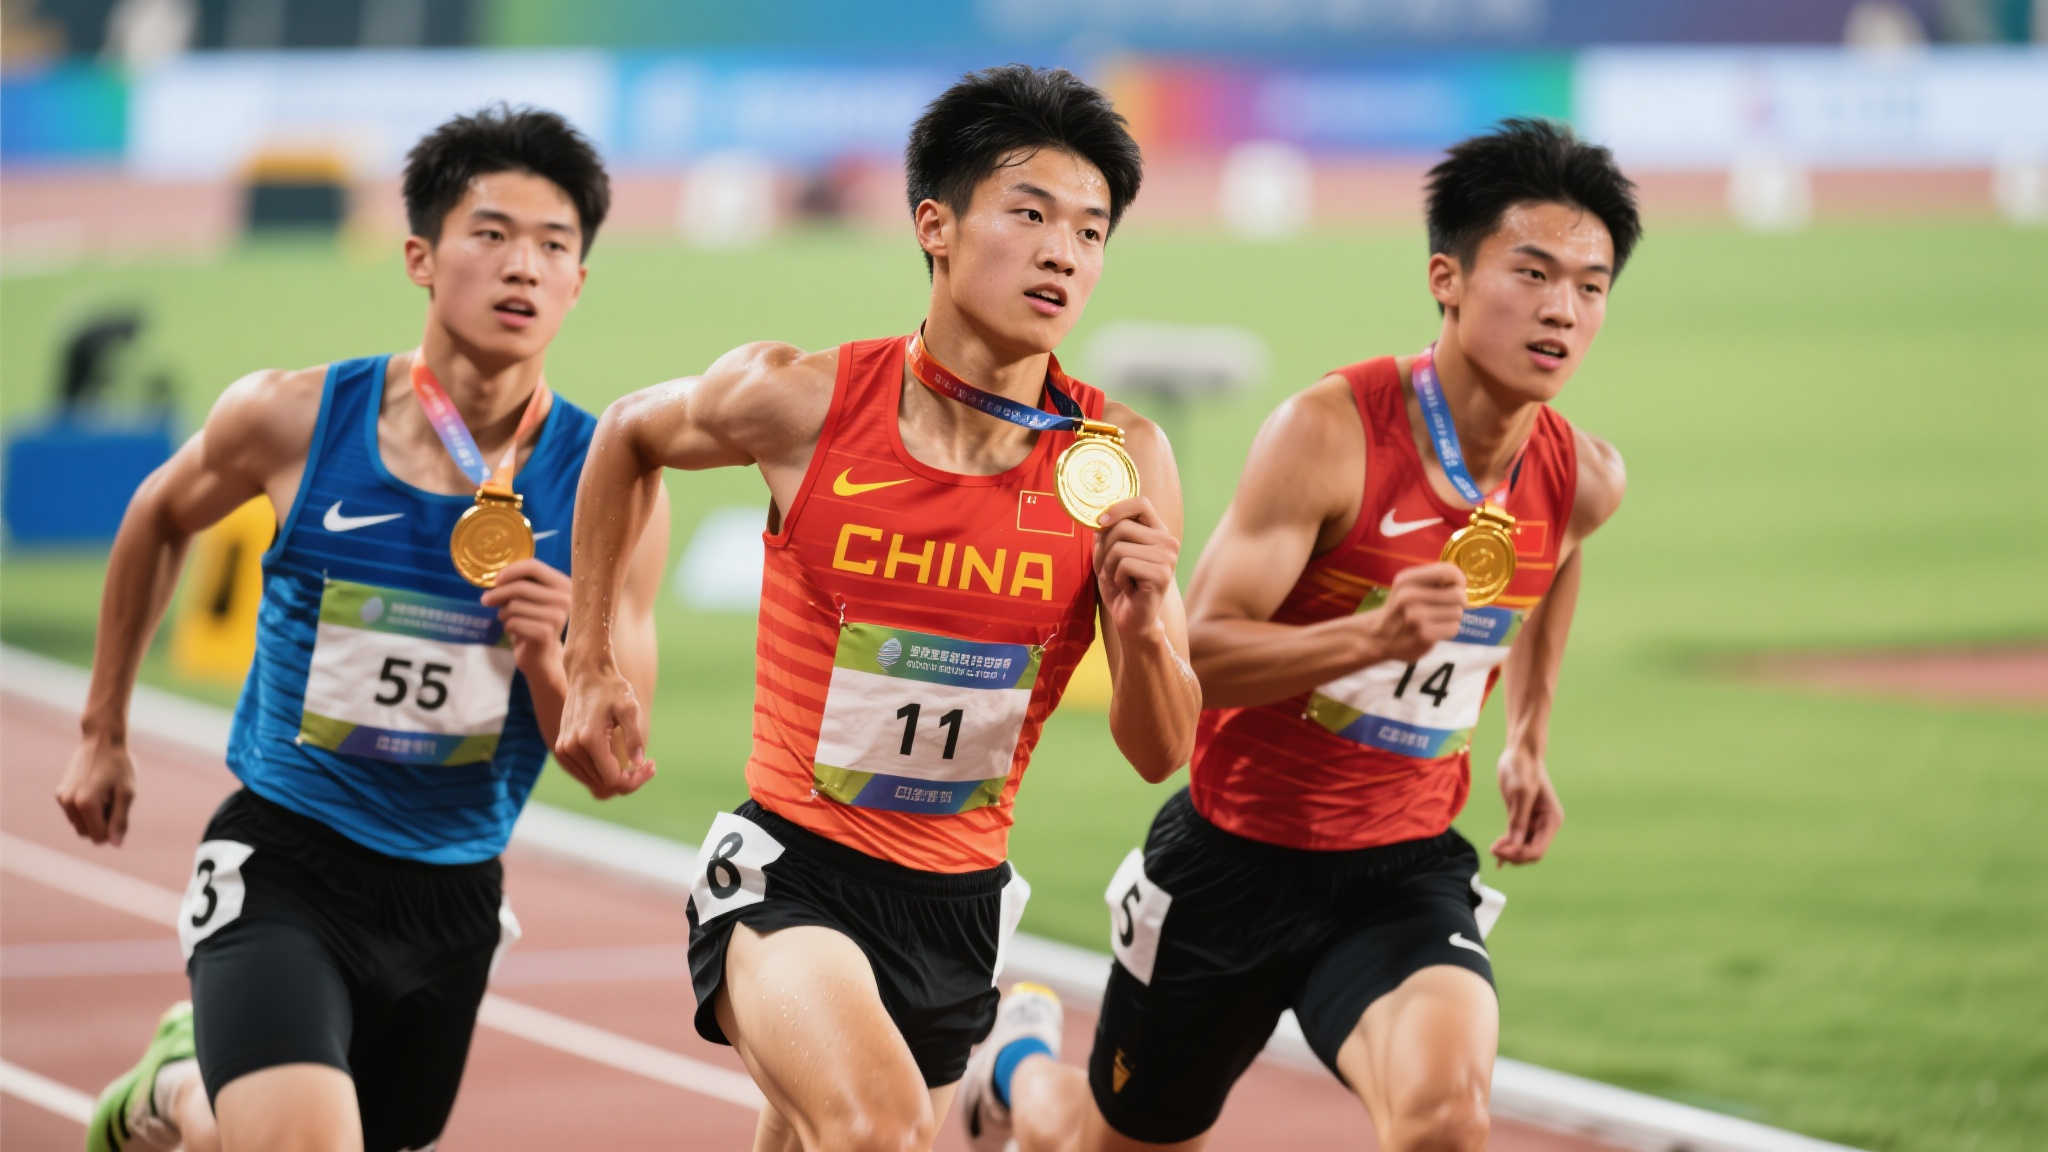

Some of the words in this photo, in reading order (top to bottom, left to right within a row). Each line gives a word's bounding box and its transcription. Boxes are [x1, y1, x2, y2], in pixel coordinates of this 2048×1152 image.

[832, 523, 1053, 601] CHINA
[374, 656, 452, 711] 55
[1392, 661, 1456, 708] 14
[896, 703, 964, 760] 11
[191, 859, 218, 928] 3
[706, 831, 743, 900] 8
[1119, 882, 1141, 948] 5
